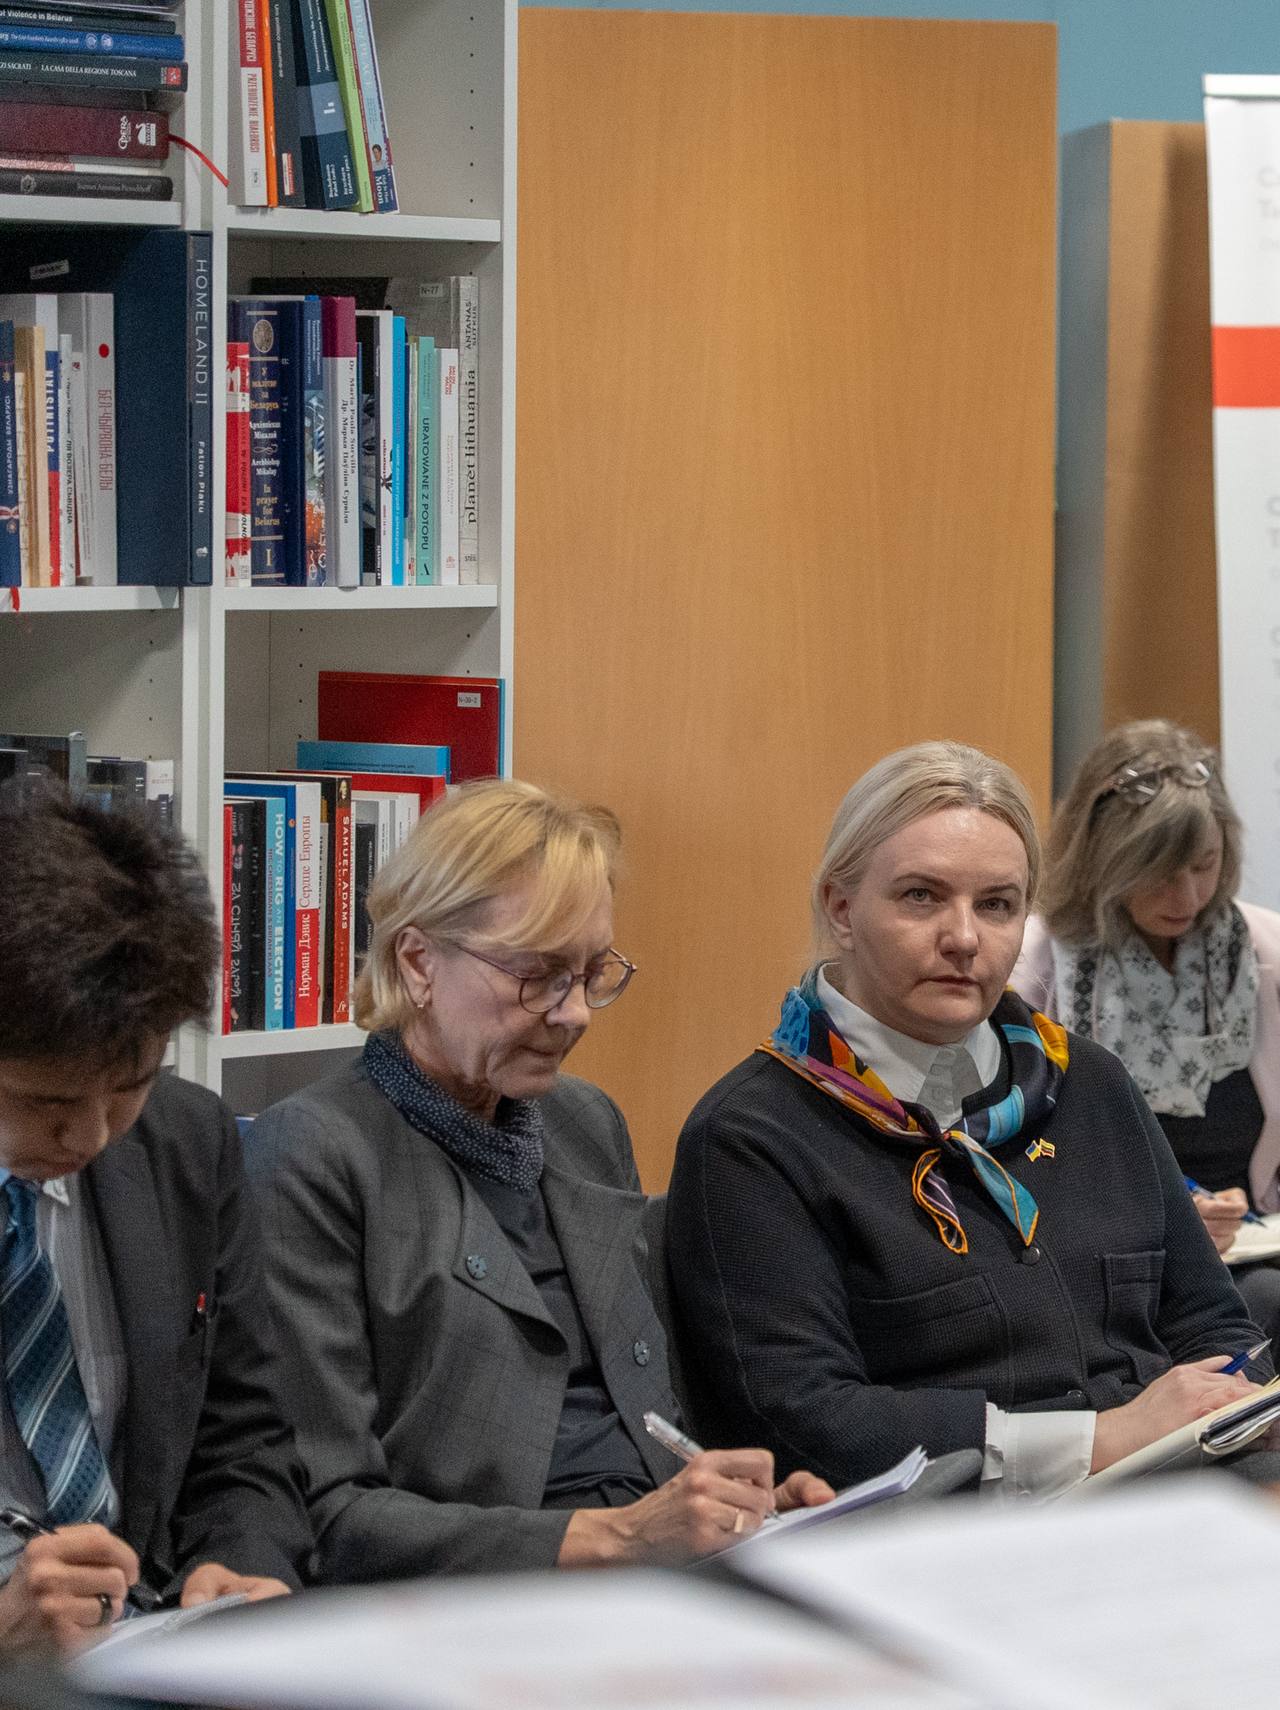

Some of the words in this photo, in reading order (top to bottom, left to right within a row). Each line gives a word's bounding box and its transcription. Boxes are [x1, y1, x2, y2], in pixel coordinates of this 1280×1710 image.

[8, 10, 37, 19] Violence
[38, 12, 45, 20] in
[46, 13, 73, 22] Belarus
[84, 67, 109, 76] REGIONE
[110, 69, 137, 77] TOSCANA
[247, 74, 260, 117] PRZEBUDZENIE
[375, 176, 384, 205] Moon
[195, 259, 208, 385] HOMELAND
[45, 370, 55, 453] PUTINISTAN
[195, 391, 208, 405] II
[464, 369, 476, 458] lithuania
[198, 441, 206, 480] Fation
[342, 451, 350, 487] Паўліна
[421, 417, 430, 490] URATOWANE
[198, 482, 206, 514] Plaku
[256, 496, 278, 507] prayer
[263, 483, 271, 493] In
[465, 463, 477, 524] planet
[255, 517, 280, 526] Belarus
[262, 506, 273, 515] for
[421, 503, 430, 550] POTOPU
[275, 813, 284, 856] HOW
[299, 815, 312, 862] Европы
[342, 816, 350, 877] SAMUEL
[276, 858, 283, 873] TO
[274, 876, 284, 905] RIG
[299, 865, 312, 908] Сердце
[342, 881, 350, 930] ADAMS
[276, 908, 282, 923] AN
[299, 914, 311, 949] Дэвис
[274, 927, 284, 1010] ELECTION
[299, 952, 311, 998] Норман
